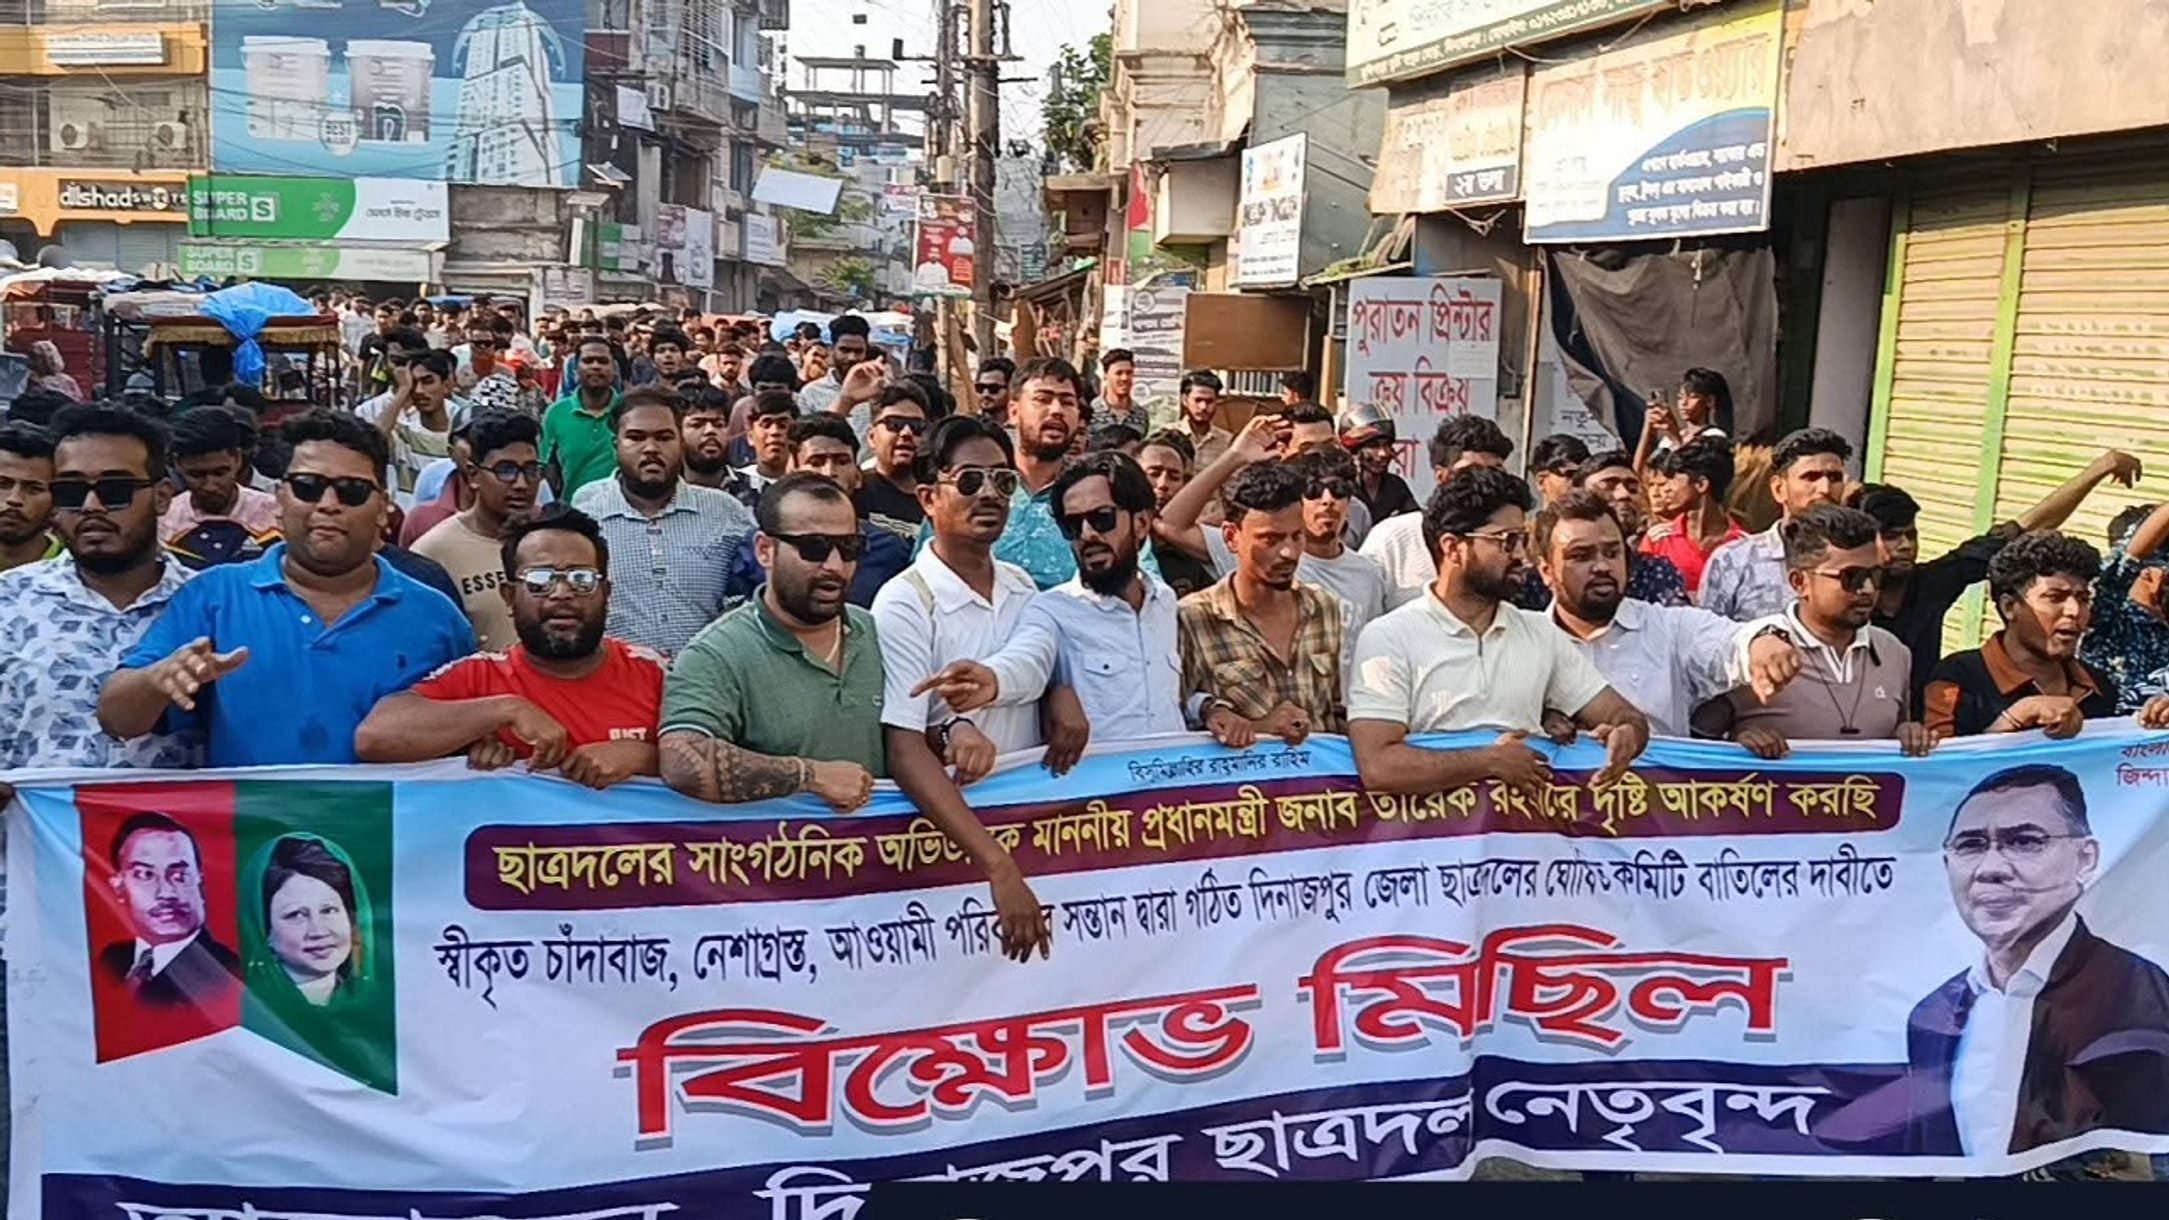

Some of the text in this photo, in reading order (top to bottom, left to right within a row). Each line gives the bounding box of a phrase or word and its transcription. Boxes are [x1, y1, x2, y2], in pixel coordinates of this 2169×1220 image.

[60, 181, 133, 207] dilshad
[193, 190, 248, 205] SUPER
[193, 206, 248, 220] BOARD
[256, 200, 271, 217] S
[186, 246, 234, 259] SUPER
[241, 254, 254, 270] S
[186, 260, 234, 272] BOARD
[1353, 283, 1494, 357] পুরাতন প্রিন্টার
[1393, 434, 1421, 478] রা
[461, 571, 505, 595] ESSE
[494, 840, 676, 895] ছাত্রদলের
[684, 820, 867, 886] সাংগঠনিক
[1032, 799, 1135, 857] মাননীয়
[1142, 784, 1271, 850] প্রধানমন্ত্রী
[1276, 787, 1359, 834] জনাব
[1367, 781, 1480, 824] তারেক
[1588, 771, 1651, 836] দৃষ্টি
[1656, 772, 1779, 821] আকর্ষণ
[1788, 776, 1882, 821] করছি
[434, 924, 533, 1008] স্বীকৃত
[543, 923, 679, 993] চাঁদাবাজ,
[693, 928, 818, 984] নেশাগ্রস্ত,
[826, 900, 937, 970] আওয়ামী
[1063, 894, 1127, 942] সন্তান
[1132, 886, 1178, 938] দ্বারা
[1185, 867, 1243, 926] গঠিত
[1248, 866, 1353, 922] দিনাজপুর
[1364, 862, 1430, 910] জেলা
[1609, 848, 1689, 900] কমিটি
[1698, 847, 1802, 900] বাতিলের
[1809, 842, 1896, 900] দাবীতে
[612, 922, 1792, 1150] বিক্ষোভ মিছিল
[1200, 1085, 1475, 1178] ছাত্রদল
[1485, 1080, 1833, 1154] নেতৃবৃন্দ
